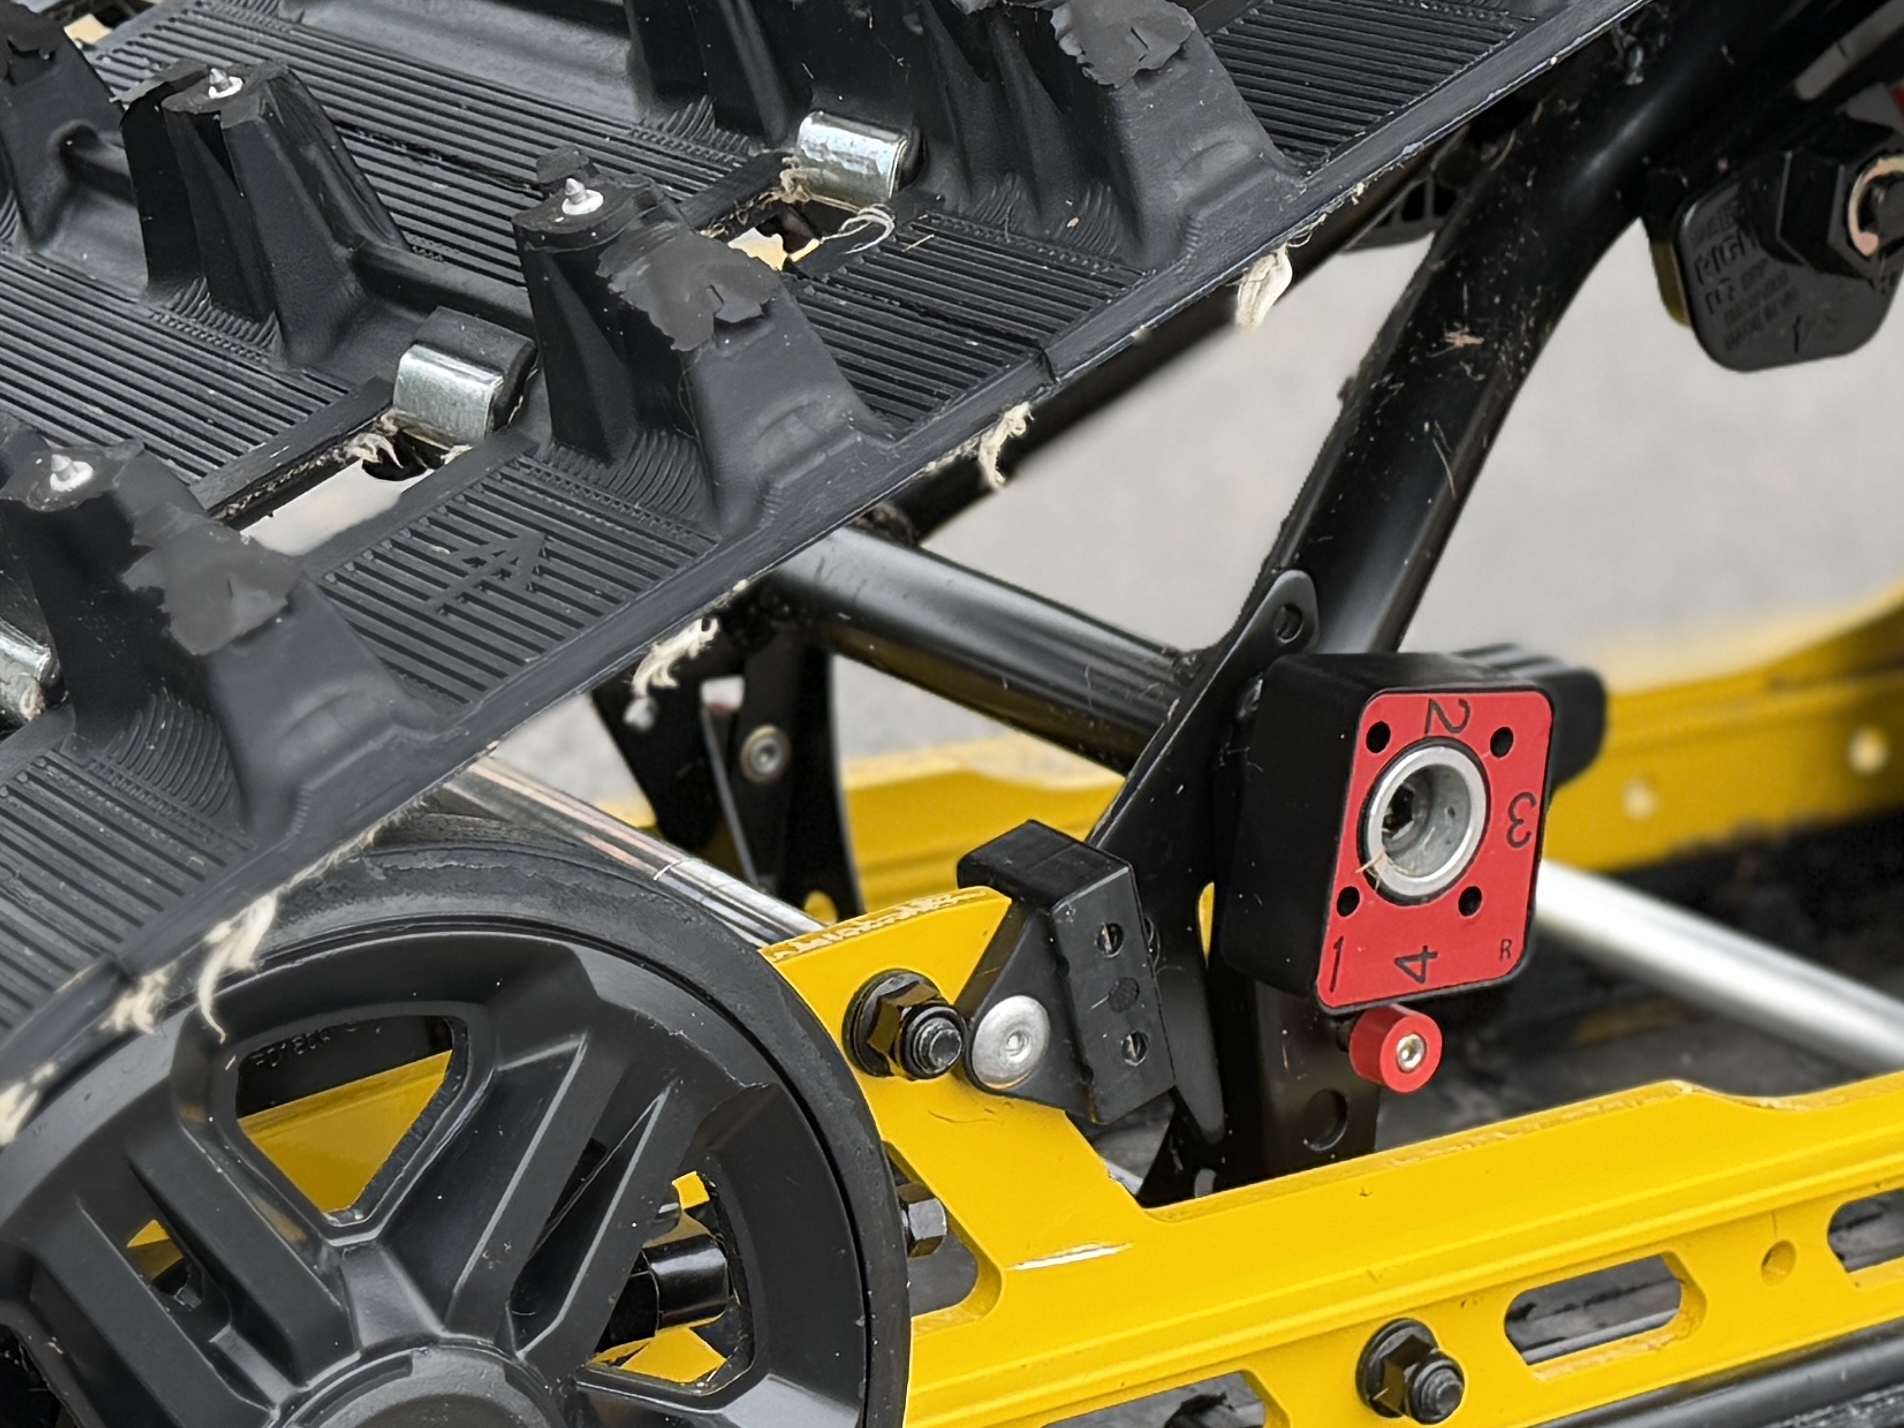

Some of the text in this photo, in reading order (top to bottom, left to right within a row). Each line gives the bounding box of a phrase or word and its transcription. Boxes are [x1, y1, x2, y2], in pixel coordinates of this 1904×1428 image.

[1424, 698, 1472, 736] 2
[1507, 792, 1535, 849] 3
[1330, 935, 1345, 993] 1
[1393, 944, 1438, 985] 4
[1498, 938, 1513, 962] R
